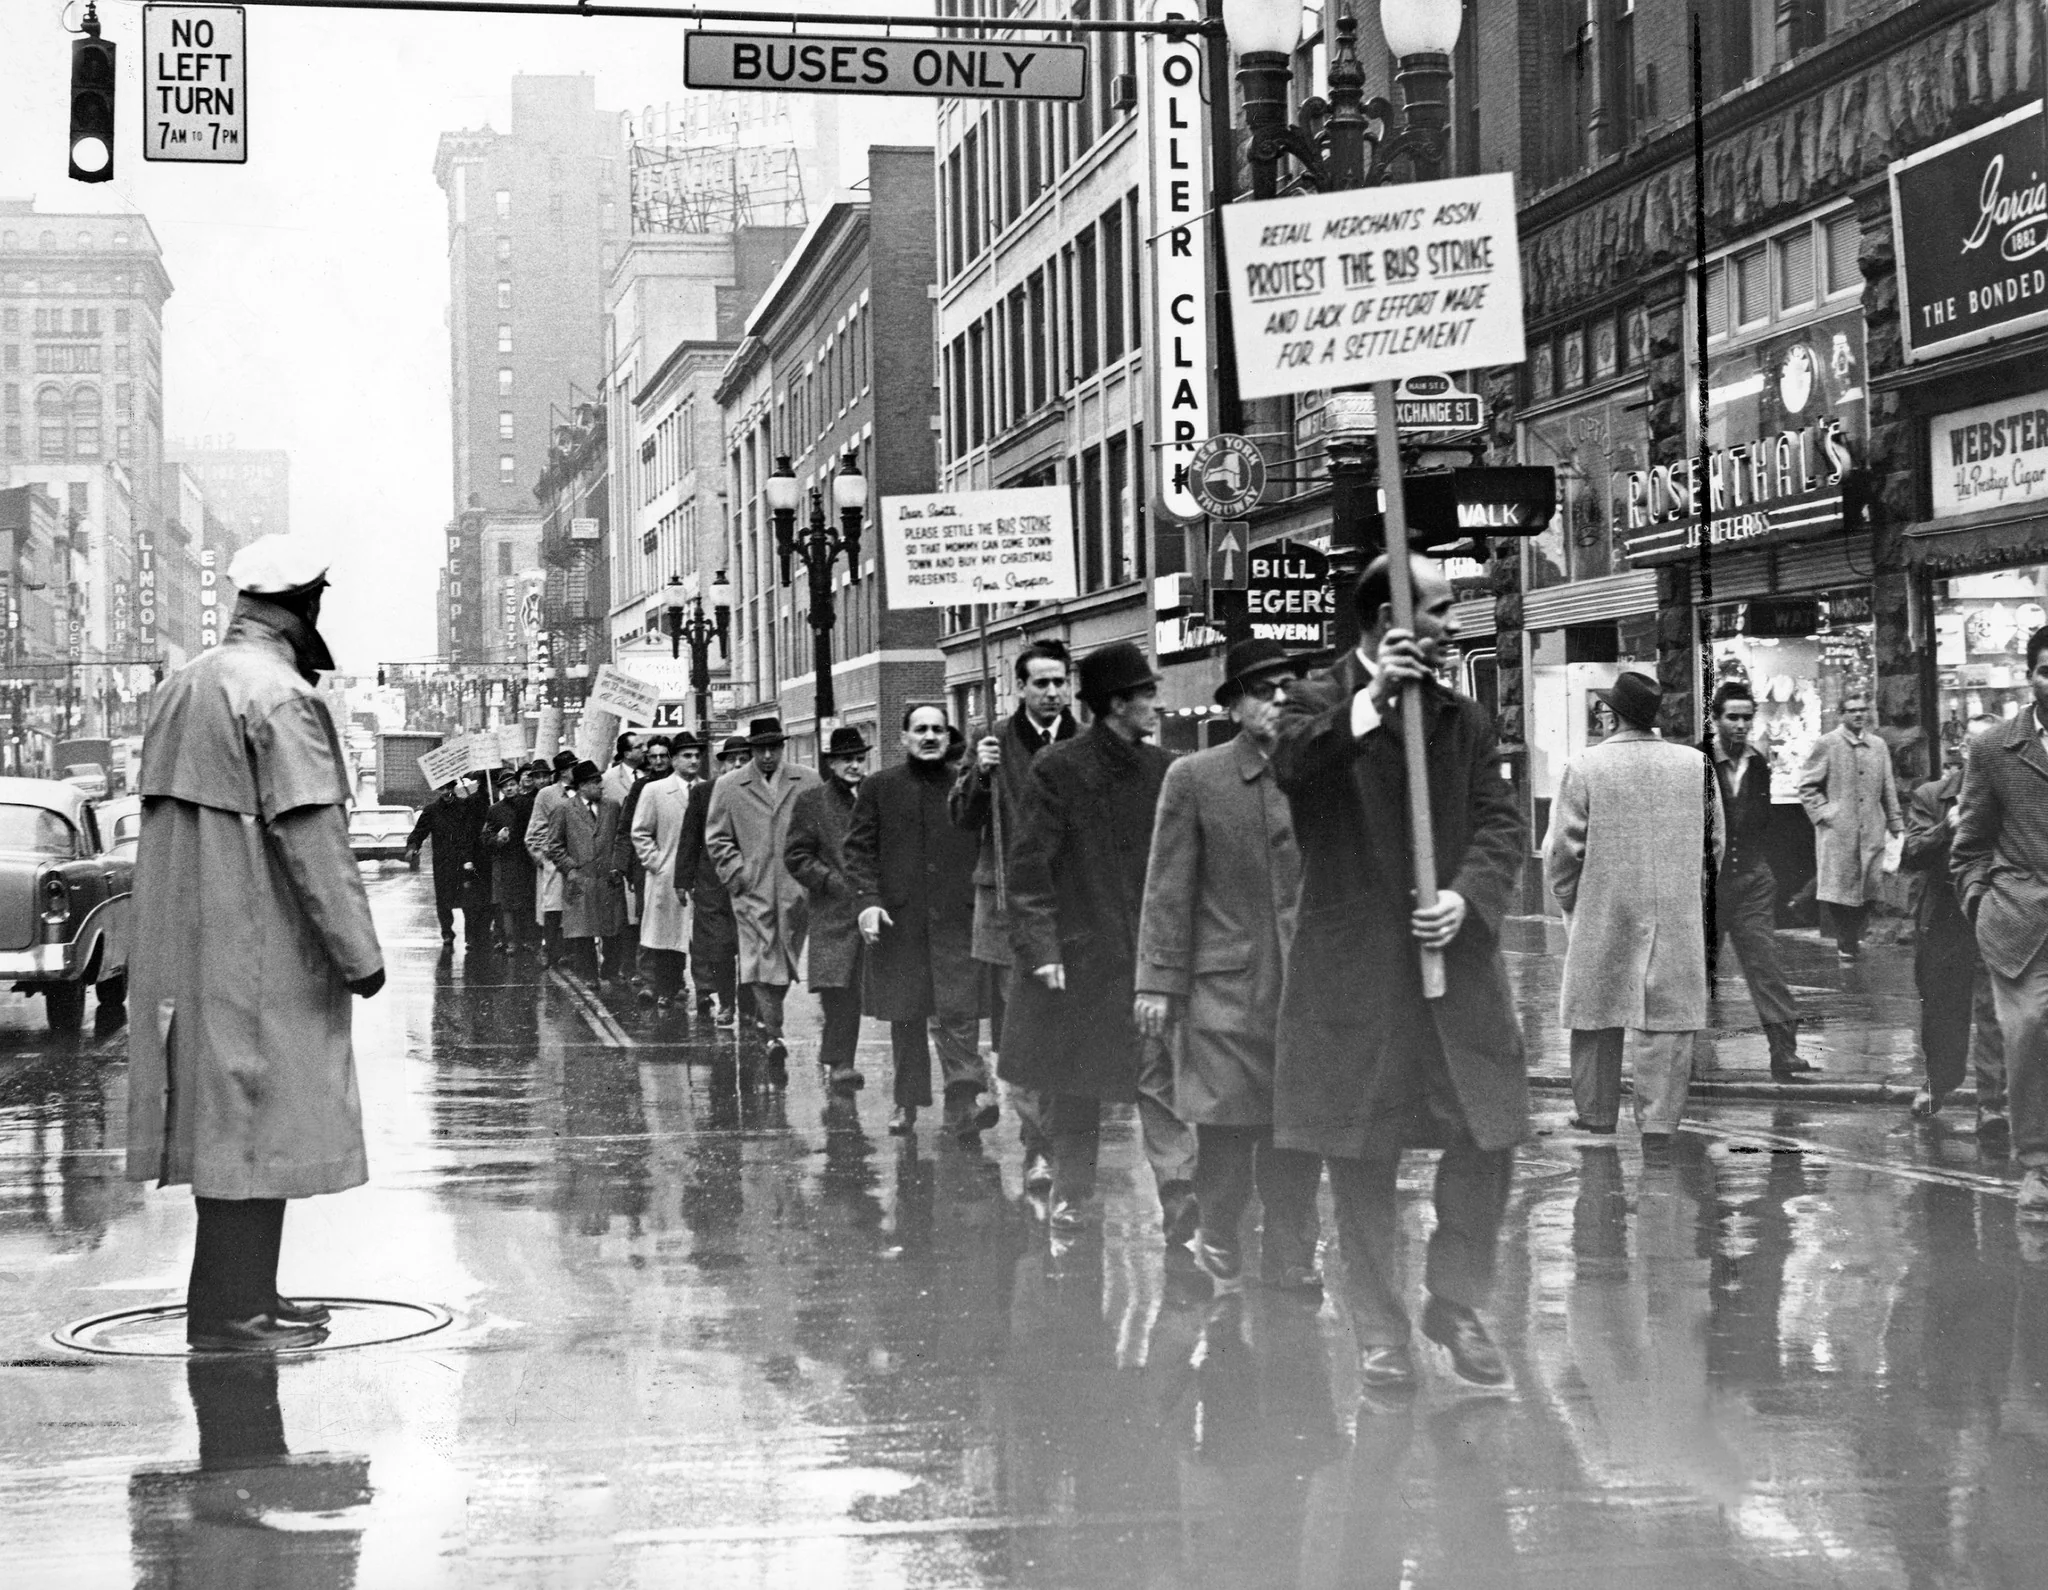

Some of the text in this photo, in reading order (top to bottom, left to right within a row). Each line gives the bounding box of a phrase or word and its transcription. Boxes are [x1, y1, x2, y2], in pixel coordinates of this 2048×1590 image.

[172, 19, 214, 48] NO
[159, 52, 232, 82] LEFT
[733, 43, 1036, 89] BUSES ONLY
[157, 86, 234, 115] TURN
[192, 130, 203, 142] TO
[1259, 222, 1312, 247] RETAIL
[1323, 208, 1425, 240] MERCHANTS
[2011, 228, 2036, 252] 1882
[1245, 236, 1494, 297] PROTEST THE BUS STRIKE
[1264, 284, 1490, 335] AND LACK OF EFFORT MADE
[1923, 269, 2046, 327] THE BONDED
[1276, 318, 1475, 370] FOR A SETTLEMENT
[1171, 294, 1198, 495] CLARK
[1408, 382, 1427, 390] MAIN
[1397, 402, 1452, 423] XCHANGE
[1192, 437, 1260, 472] NEW YORK
[1628, 416, 1848, 528] ROSENTHAL'S
[899, 505, 923, 520] Dear
[1197, 486, 1259, 514] THRUWAY
[904, 515, 1052, 540] PLEASE SETTLE THE BUS STRIKE
[905, 544, 917, 555] SO
[920, 543, 941, 554] THAT
[945, 541, 979, 552] MOMMY
[981, 539, 999, 550] CAN
[1002, 537, 1024, 549] COME
[907, 550, 1053, 570] TOWN AND BUY MY CHRISTMAS
[1252, 559, 1316, 580] BILL
[200, 550, 217, 645] EDWAR
[1250, 622, 1320, 641] TAVERN
[657, 705, 683, 725] 14
